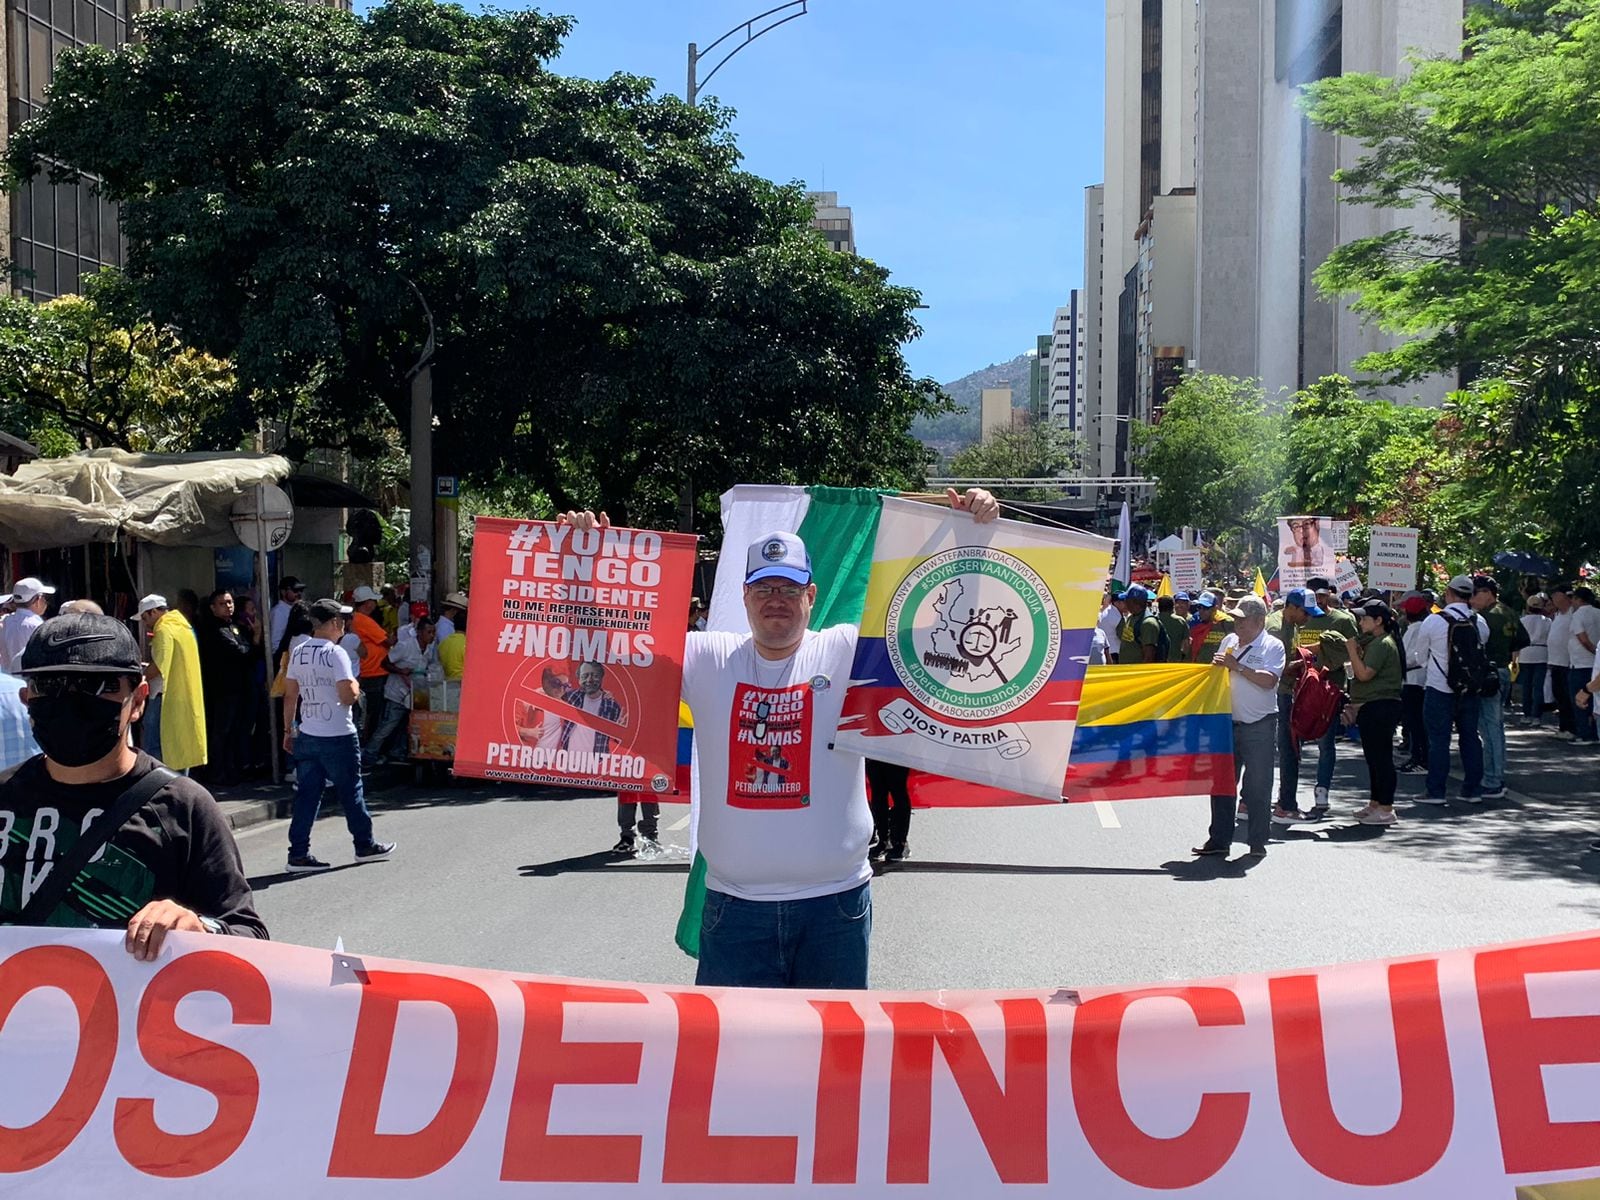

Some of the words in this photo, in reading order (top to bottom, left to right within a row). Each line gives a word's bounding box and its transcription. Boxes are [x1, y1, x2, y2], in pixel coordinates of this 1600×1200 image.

[508, 523, 662, 561] #YONO
[505, 550, 662, 587] TENGO
[914, 549, 1051, 604] WWW.STEFANBRAVOACTIVISTA.COM
[502, 579, 659, 609] PRESIDENTE
[920, 561, 1042, 615] #SOYRESERVAANTIOQUIA
[503, 599, 520, 609] NO
[525, 601, 545, 611] ME
[549, 604, 629, 619] REPRESENTA
[634, 611, 651, 621] UN
[503, 611, 565, 624] GUERRILLERO
[577, 617, 650, 631] INDEPENDIENTE
[496, 623, 656, 667] #NOMAS
[1045, 609, 1058, 670] #SOYVEEDOR
[910, 662, 1020, 706] #Derechoshumanos
[939, 669, 1048, 718] #ABOGADOSPORLAVERDAD
[953, 729, 1008, 745] PATRIA
[486, 742, 645, 779] PETROYQUINTERO
[485, 769, 644, 791] www.stefanbravoactivista.com
[735, 780, 801, 794] PETROYQUINTERO
[327, 936, 1600, 1189] DELINCUE
